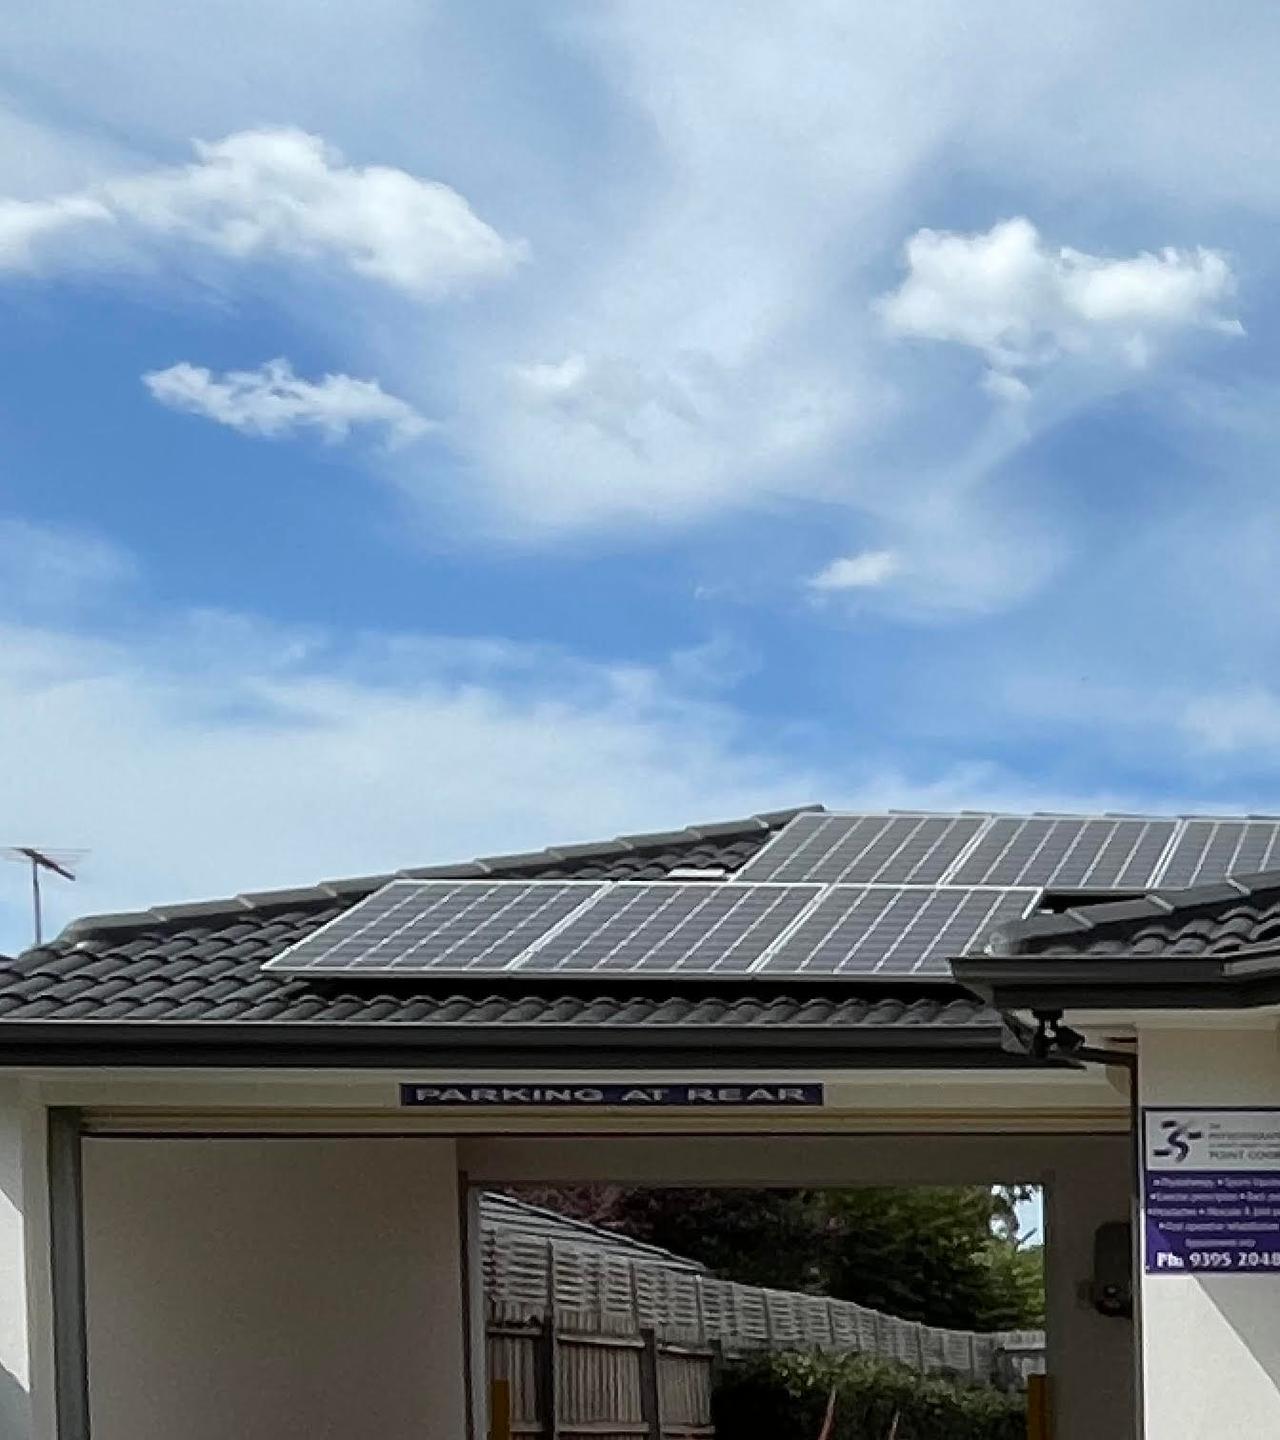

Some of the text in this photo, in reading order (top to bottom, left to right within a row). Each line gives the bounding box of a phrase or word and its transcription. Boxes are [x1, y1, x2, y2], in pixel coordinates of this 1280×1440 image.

[416, 1088, 805, 1101] PARKING AT REAR
[1189, 1251, 1232, 1267] 9395
